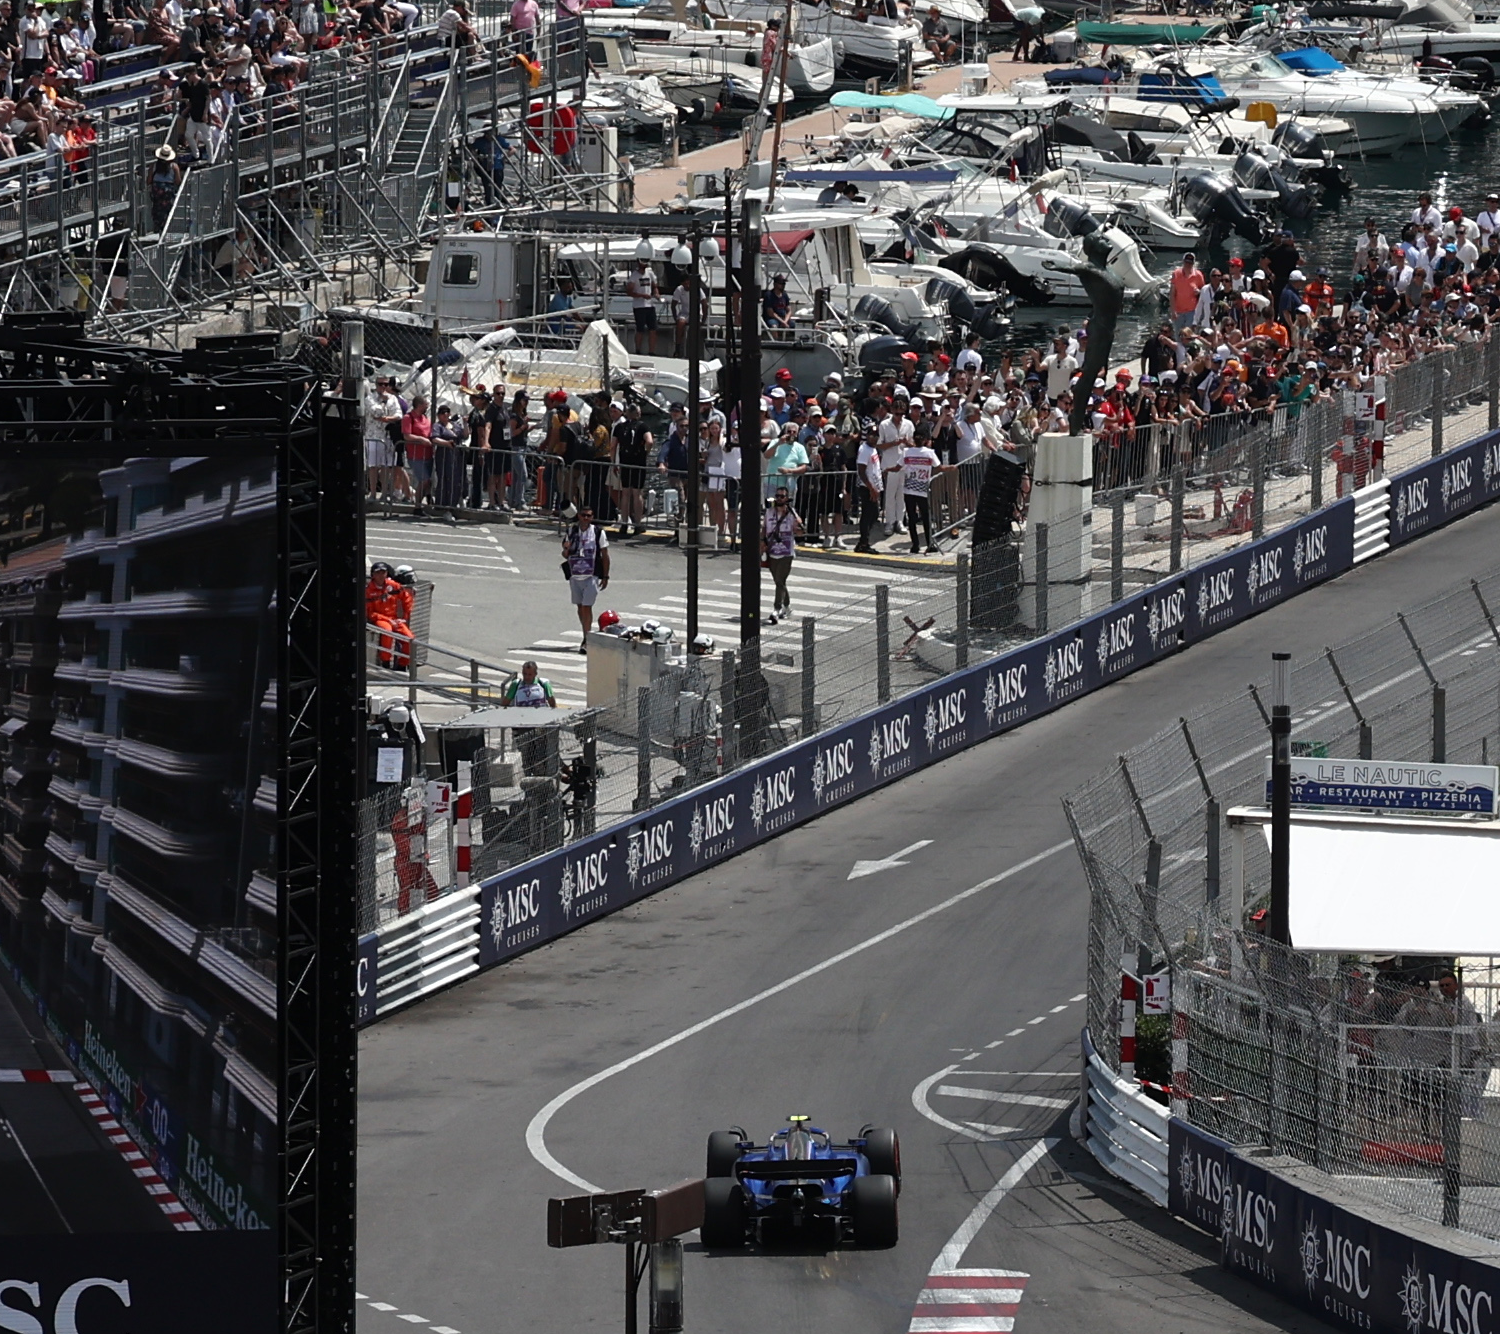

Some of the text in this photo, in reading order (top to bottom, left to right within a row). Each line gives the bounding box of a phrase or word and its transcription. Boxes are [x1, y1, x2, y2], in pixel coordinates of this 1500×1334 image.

[1407, 477, 1429, 515] MSC
[1451, 456, 1472, 495] MSC
[1305, 525, 1328, 565] MSC
[1209, 568, 1234, 608] MSC
[1259, 547, 1282, 587] MSC
[1160, 590, 1185, 631] MSC
[1109, 614, 1135, 656] MSC
[1056, 639, 1084, 682] MSC
[998, 664, 1027, 707] MSC
[938, 688, 966, 733] MSC
[883, 715, 911, 759] MSC
[826, 739, 854, 784] MSC
[1317, 765, 1443, 787] LE NAUTIC
[766, 767, 795, 812] MSC
[1320, 788, 1405, 800] RESTAURANT
[1421, 792, 1482, 803] PIZZERIA
[704, 793, 735, 840] MSC
[642, 820, 673, 867] MSC
[576, 848, 608, 897] MSC
[642, 863, 673, 887] CRUISES
[507, 879, 540, 927] MSC
[575, 894, 608, 917] CRUISES
[507, 925, 540, 948] CRUISES
[84, 1019, 132, 1104] Heineken
[1197, 1154, 1221, 1204] MS
[1235, 1184, 1276, 1254] MSC
[1234, 1248, 1276, 1283] CRUISES
[1324, 1229, 1371, 1300] MSC
[1324, 1297, 1371, 1330] CRUISES
